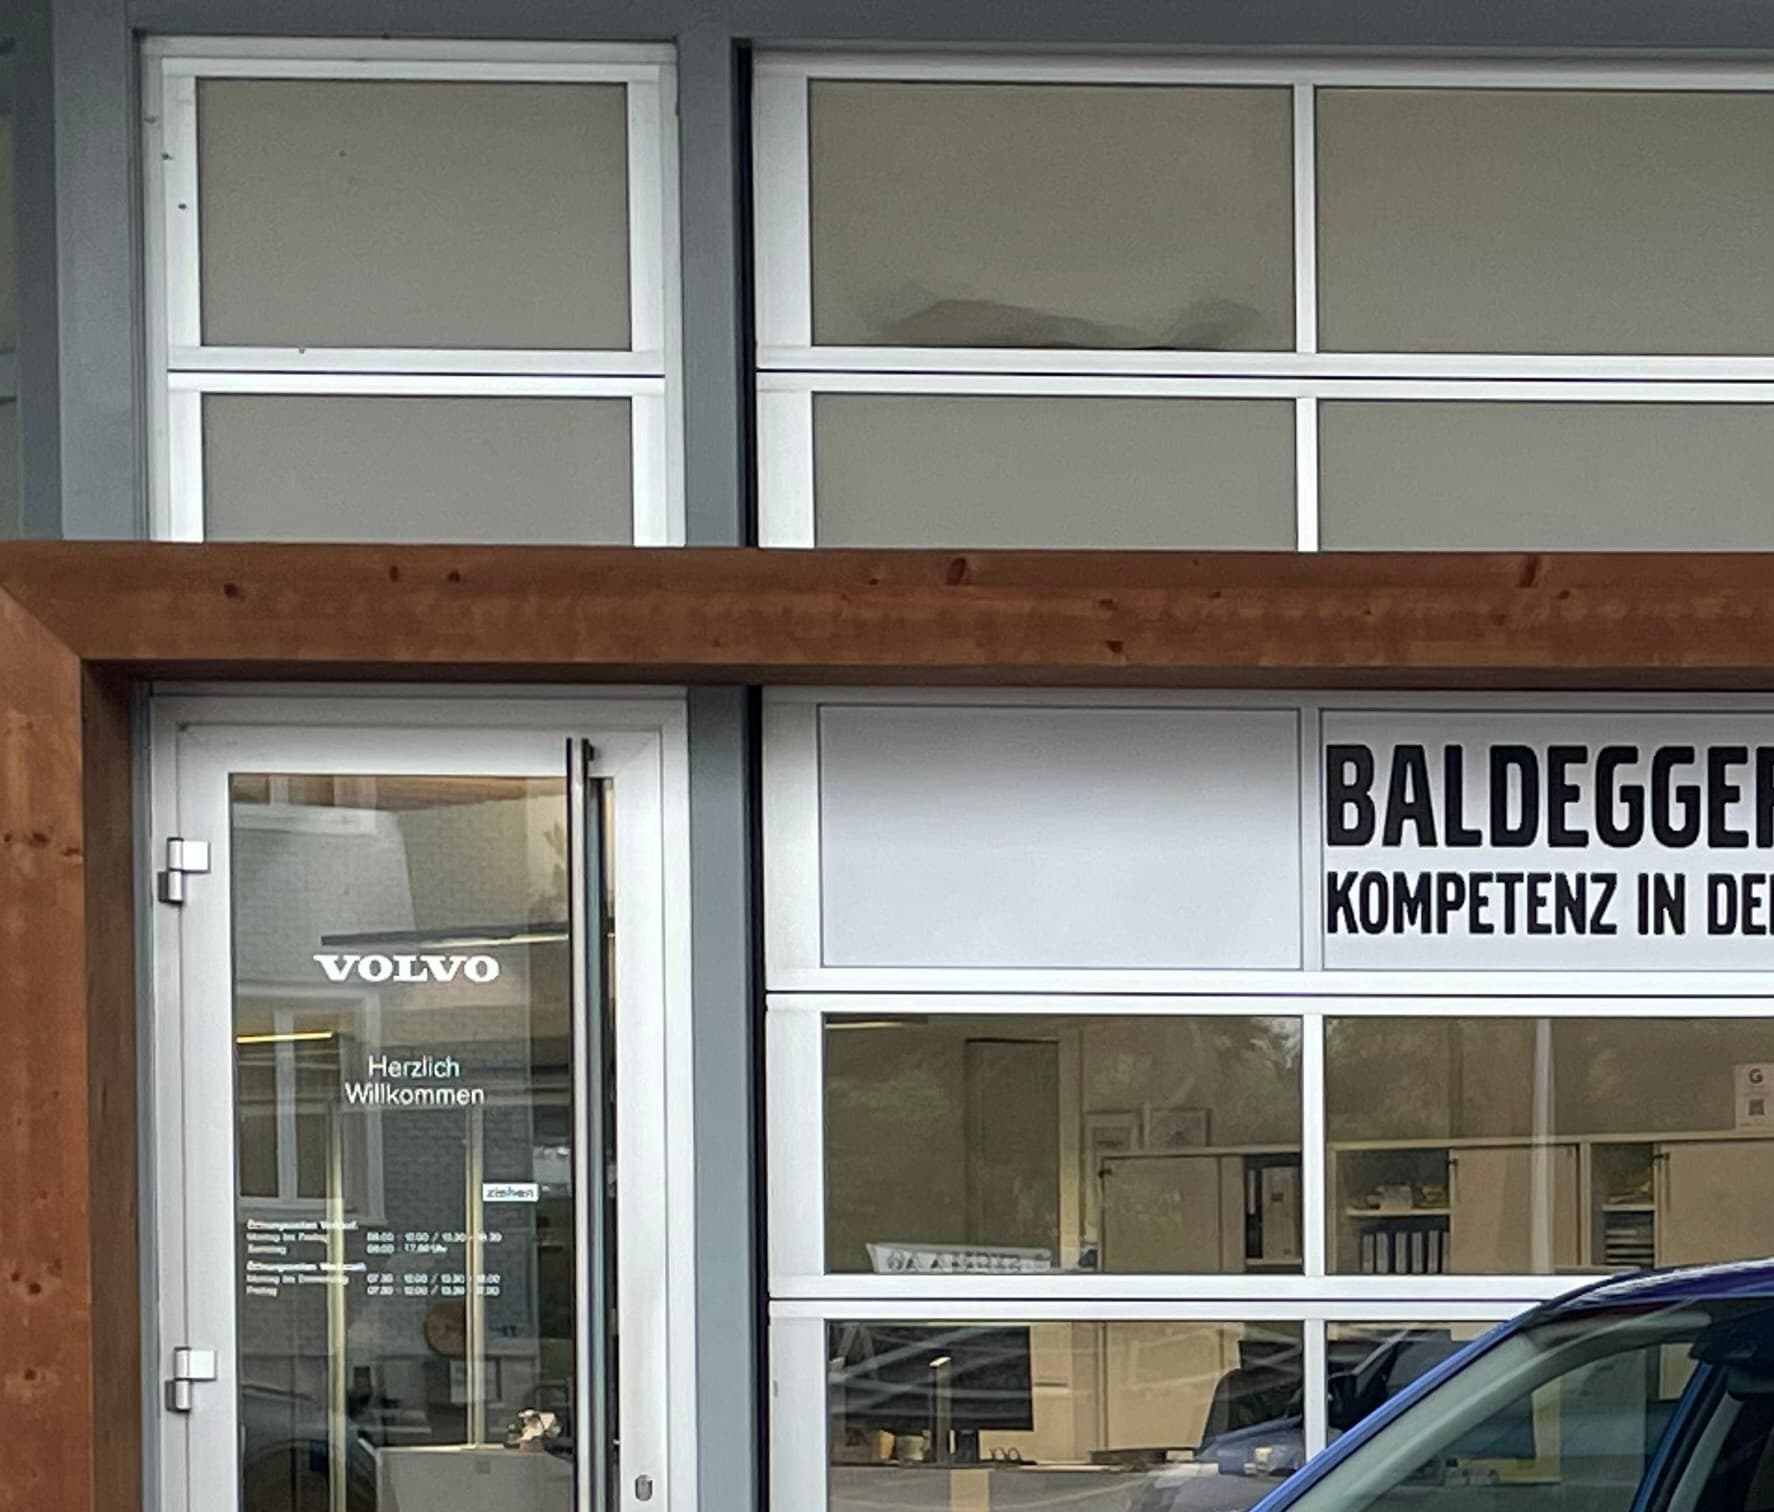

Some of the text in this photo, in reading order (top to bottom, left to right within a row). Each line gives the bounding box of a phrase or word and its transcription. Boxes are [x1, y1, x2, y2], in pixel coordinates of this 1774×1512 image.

[1327, 871, 1617, 935] KOMPETENZ
[1638, 873, 1686, 935] IN
[313, 954, 500, 983] VOLVO
[368, 1055, 460, 1078] Herzlich
[345, 1081, 485, 1106] Willkommen
